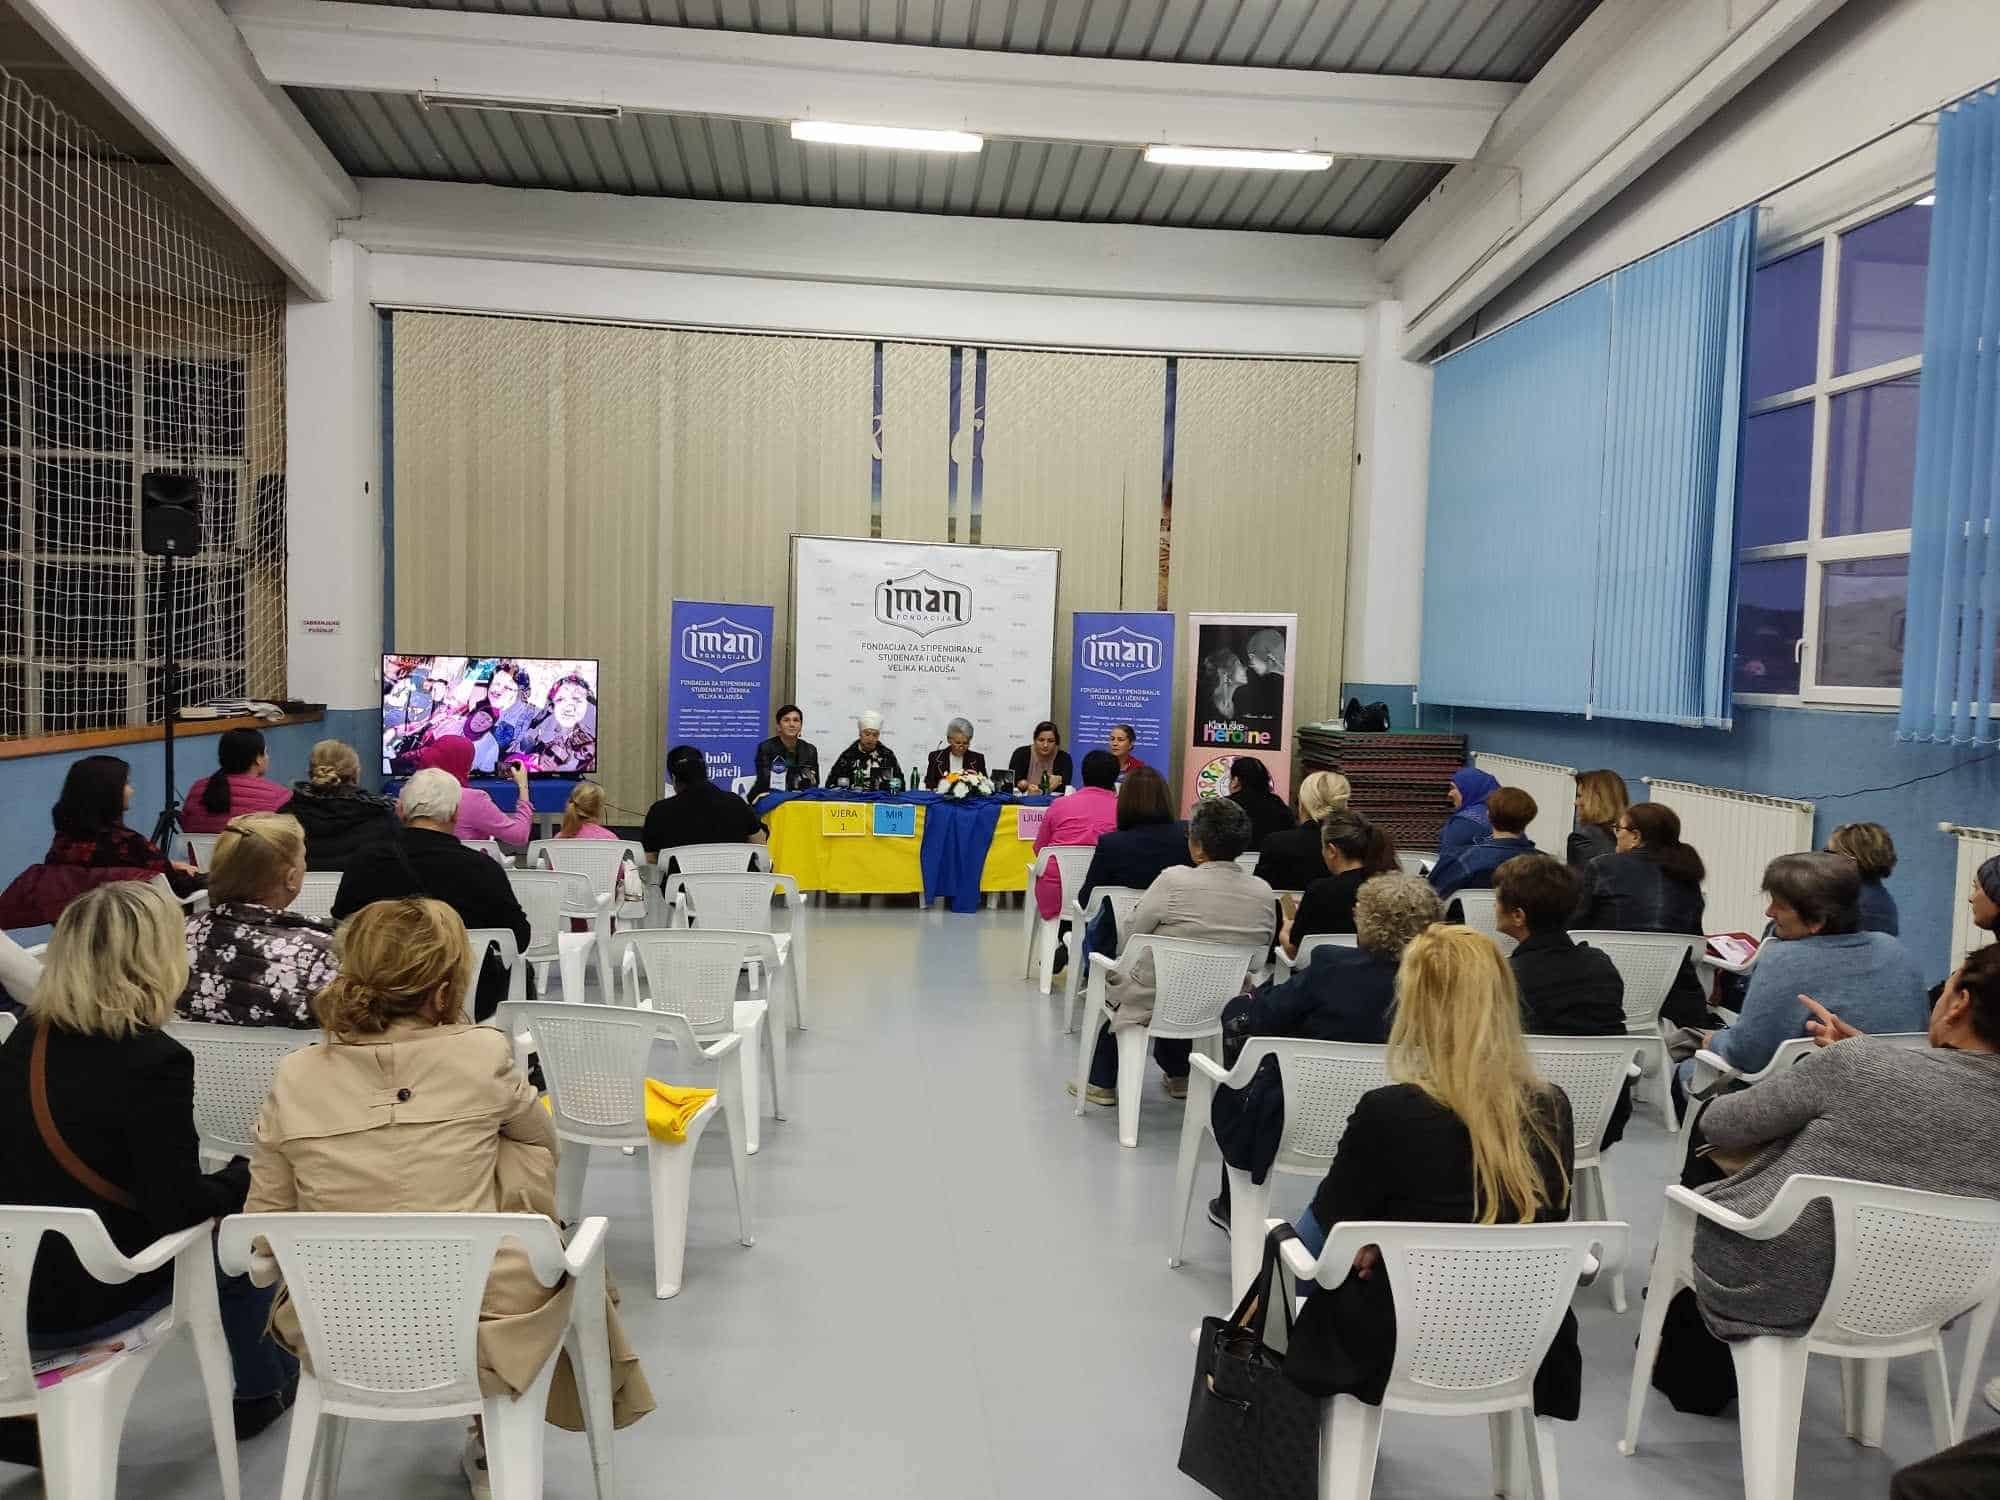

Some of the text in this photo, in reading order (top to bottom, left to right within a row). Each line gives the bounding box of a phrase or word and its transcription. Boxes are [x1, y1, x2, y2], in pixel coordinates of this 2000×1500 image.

[883, 579, 962, 621] iman
[896, 614, 952, 622] FONDACIJA
[689, 624, 755, 660] iman
[861, 642, 984, 655] FONDACIJA ZA STIPENDIRANJE
[1088, 634, 1154, 668] iman
[878, 653, 924, 663] STUDENATA
[931, 653, 967, 664] UČENIKA
[887, 663, 956, 674] VELIKA KLADUŠA
[1203, 723, 1272, 745] heroine
[830, 808, 858, 818] VJERA
[885, 808, 904, 819] MIR
